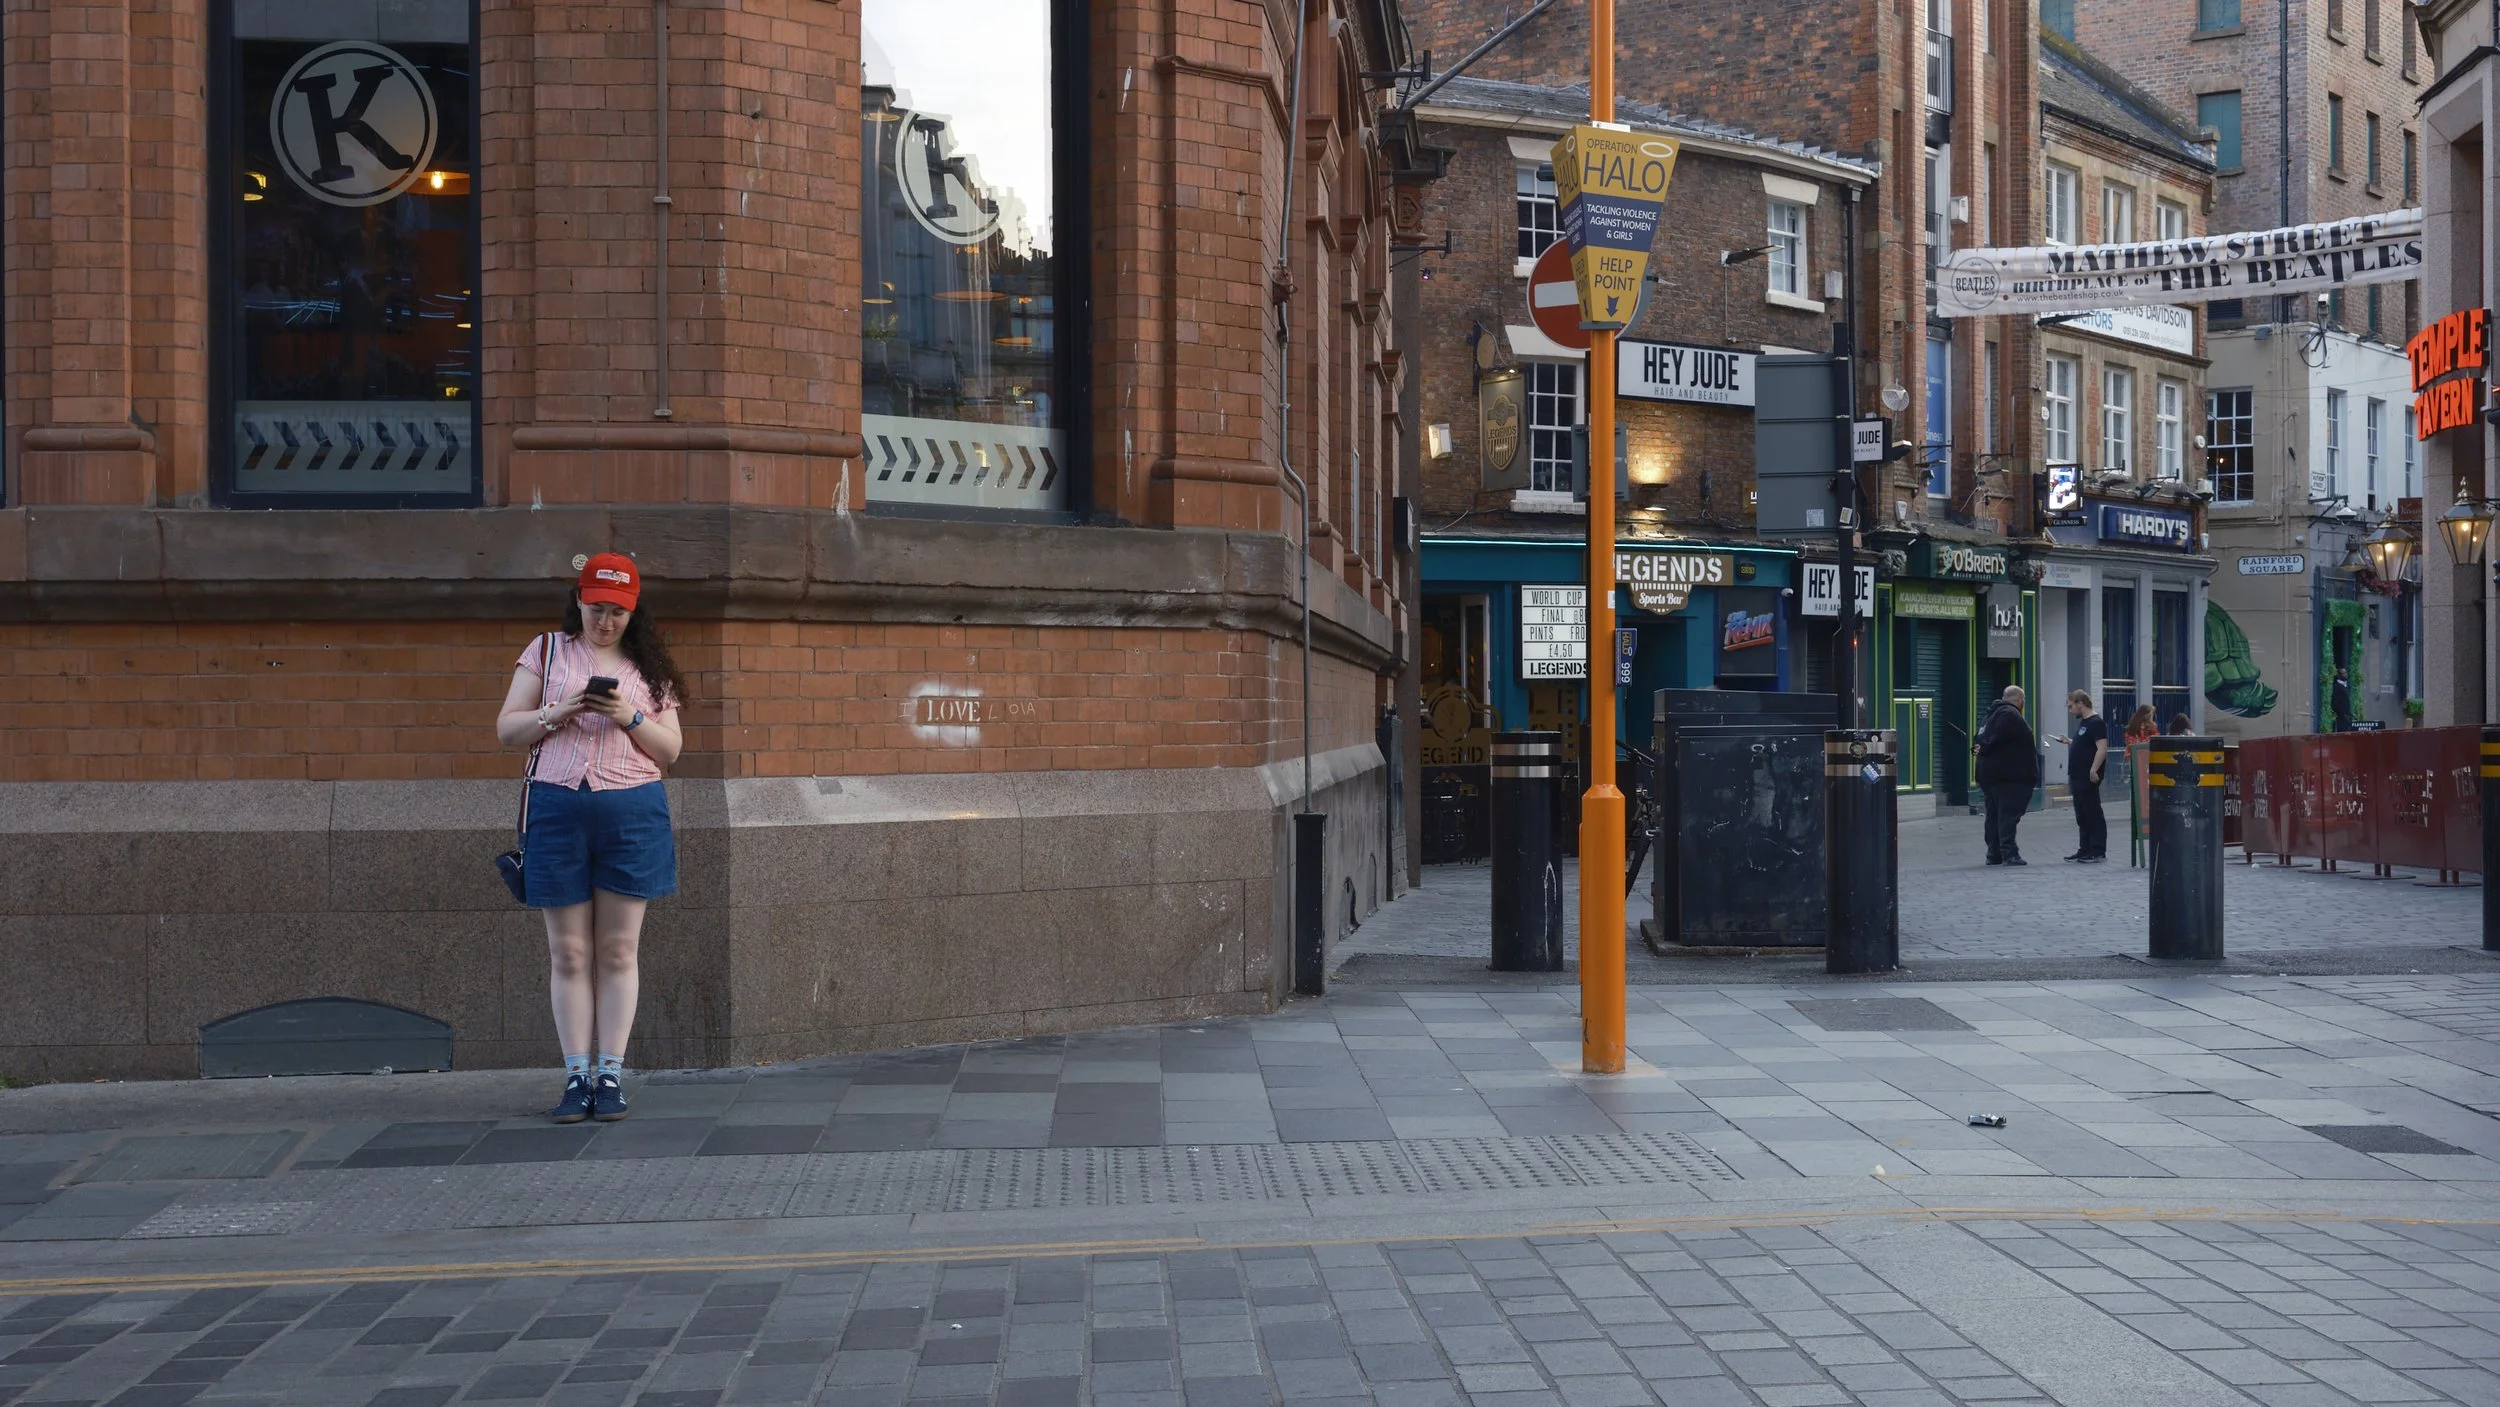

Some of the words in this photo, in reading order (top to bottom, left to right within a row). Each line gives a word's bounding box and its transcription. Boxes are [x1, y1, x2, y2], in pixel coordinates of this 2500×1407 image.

[294, 64, 414, 184] K
[1586, 138, 1638, 154] OPERATION
[1583, 151, 1666, 194] HALO
[1586, 203, 1622, 216] TACKLING
[1622, 208, 1657, 221] VIOLENCE
[1590, 216, 1621, 229] AGAINST
[1622, 220, 1652, 232] WOMEN
[1606, 230, 1613, 239] &
[1613, 230, 1634, 241] GIRLS
[2226, 219, 2381, 261] STREET
[1600, 257, 1633, 274] HELP
[2046, 239, 2215, 274] MATHEW
[2153, 263, 2232, 292] THE
[2246, 239, 2422, 284] BEATLES
[1594, 274, 1636, 292] POINT
[1955, 275, 1996, 295] BEATLES
[2012, 275, 2129, 294] BIRTHPLACE
[2134, 274, 2149, 286] of
[2016, 289, 2125, 303] www.thebeatleshop.co.uk
[2406, 308, 2484, 394] TEMPLE
[1644, 345, 1685, 386] HEY
[1690, 350, 1740, 391] JUDE
[1654, 386, 1674, 398] HAIR
[1678, 389, 1694, 400] AND
[1698, 391, 1729, 402] BEAUTY
[2413, 376, 2474, 442] TAVERN
[1857, 430, 1881, 445] JUDE
[2053, 518, 2080, 526] GUINNESS
[2122, 513, 2188, 541] HARDY'S
[1616, 554, 1723, 583] EGENDS
[2242, 556, 2300, 566] RAINFORD
[2249, 565, 2294, 574] SQUARE
[1808, 568, 1836, 599] HEY
[1532, 591, 1560, 605] WORLD
[1566, 591, 1583, 606] CUP
[1639, 592, 1666, 609] Sports
[1666, 592, 1684, 605] Bar
[1541, 609, 1565, 623] FINAL
[1530, 626, 1554, 641] PINTS
[1570, 626, 1586, 640] FRO
[1549, 643, 1573, 658] £4.50
[1622, 631, 1630, 655] HALO
[1621, 662, 1631, 684] 999
[927, 699, 981, 722] LOVE
[1420, 746, 1484, 765] EGEND
